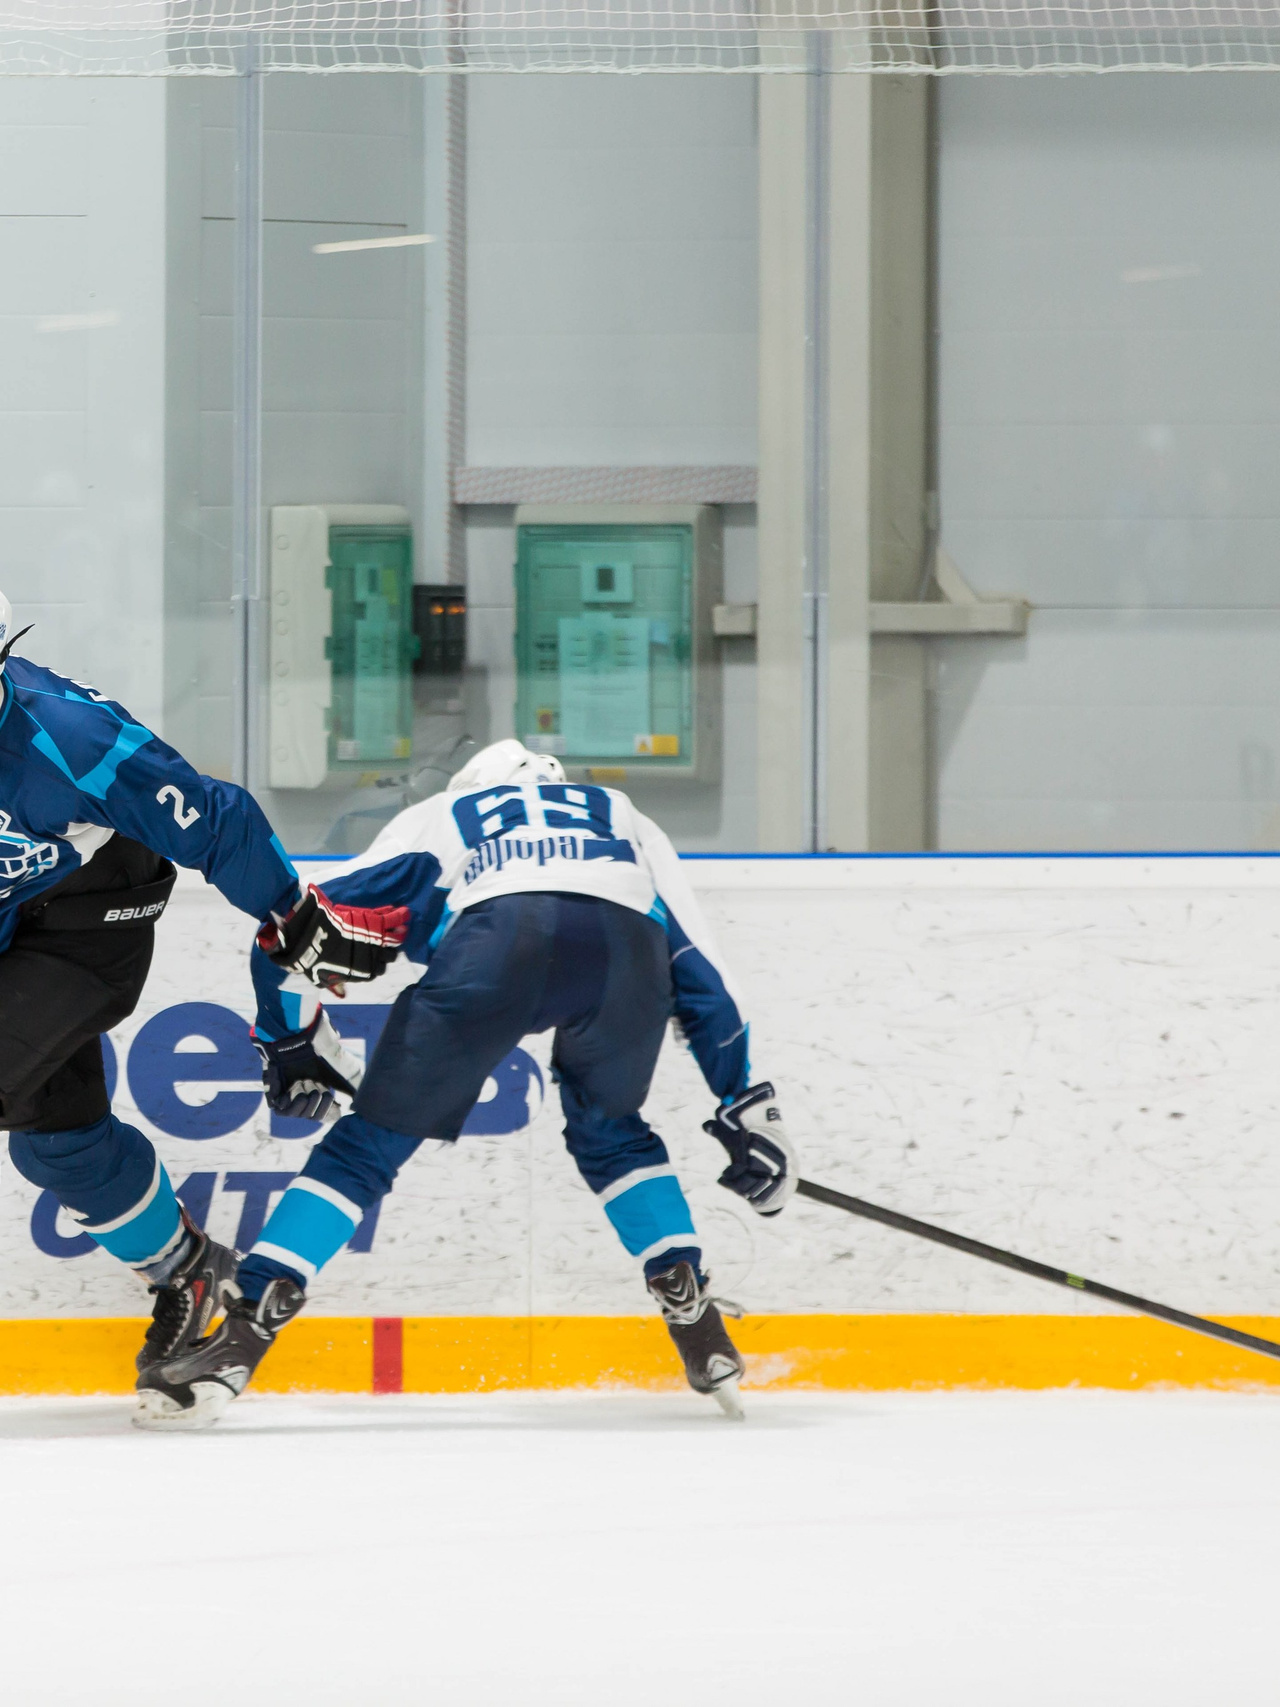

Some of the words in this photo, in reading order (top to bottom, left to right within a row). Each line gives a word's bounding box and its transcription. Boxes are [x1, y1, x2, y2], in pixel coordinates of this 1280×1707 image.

[156, 785, 201, 830] 2
[451, 784, 616, 850] 69
[103, 900, 166, 922] BAUER
